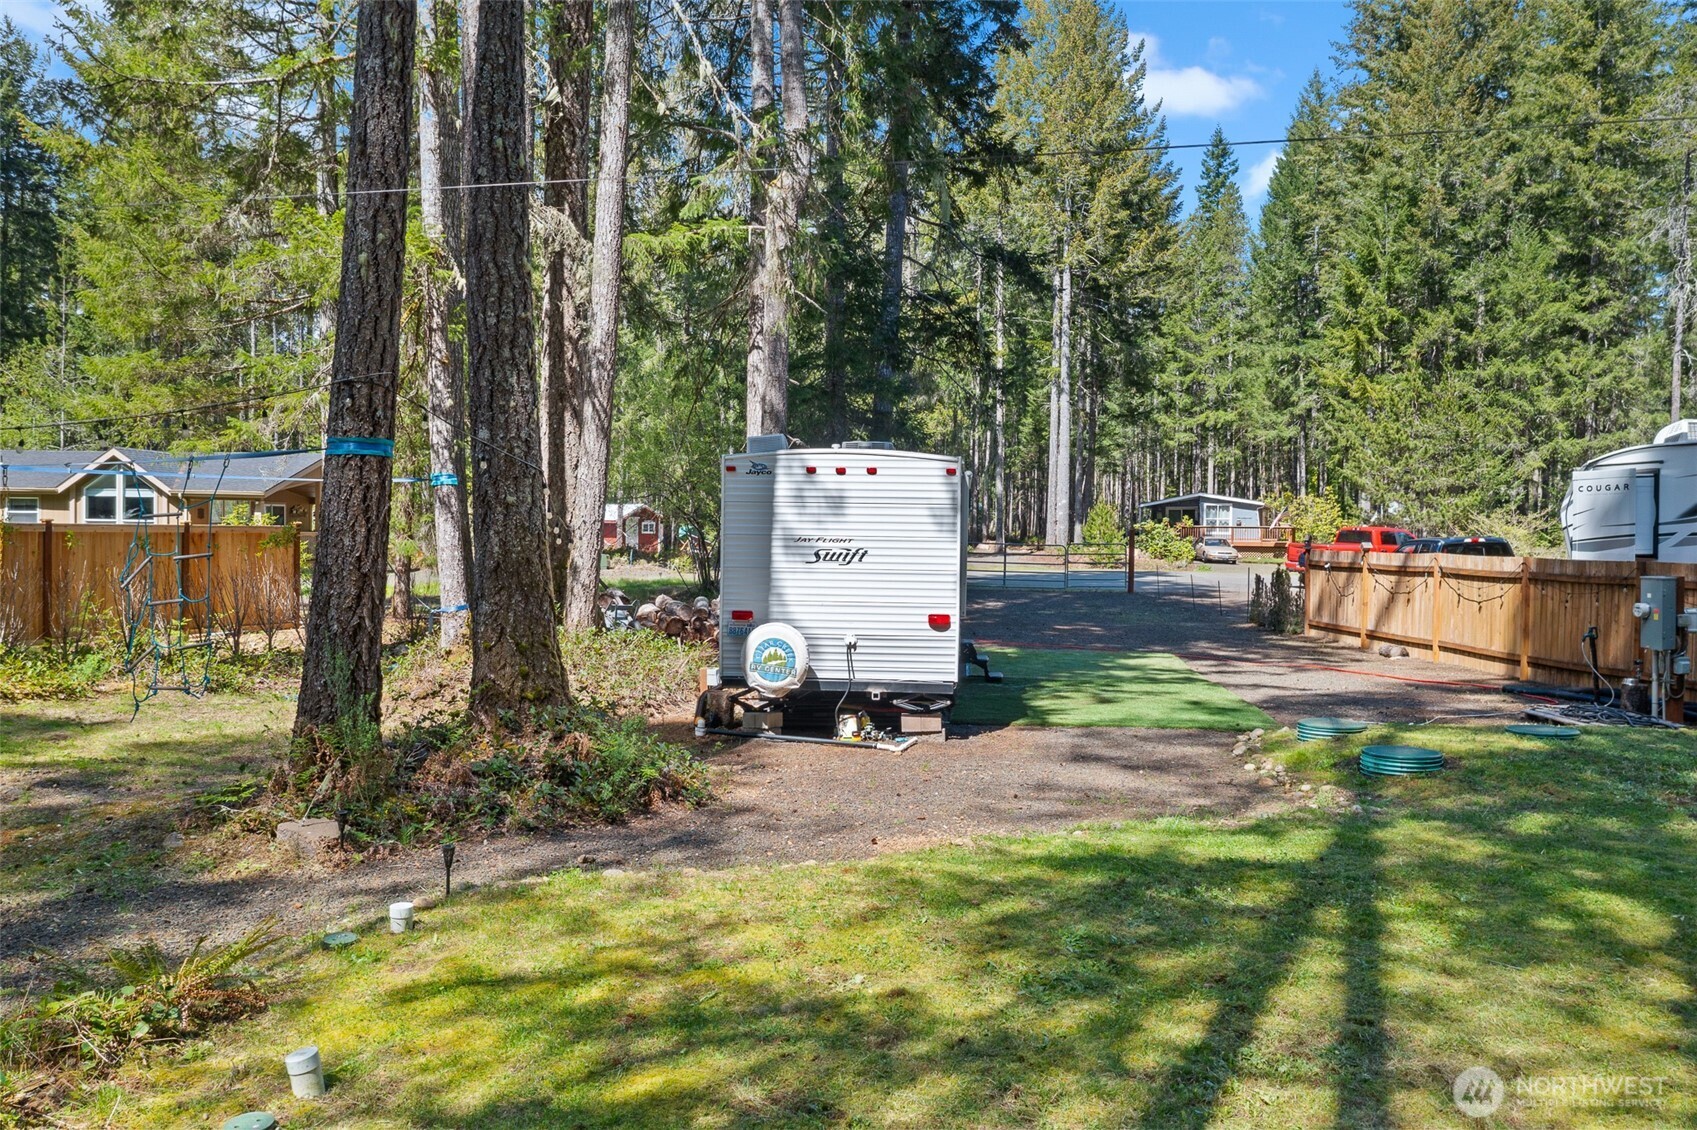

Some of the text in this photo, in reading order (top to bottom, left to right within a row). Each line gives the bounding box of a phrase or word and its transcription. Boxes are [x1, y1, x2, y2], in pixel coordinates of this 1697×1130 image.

[745, 468, 772, 476] Jayco
[1578, 483, 1630, 492] COUGAR
[805, 547, 869, 566] Swift
[764, 666, 797, 676] CENTER
